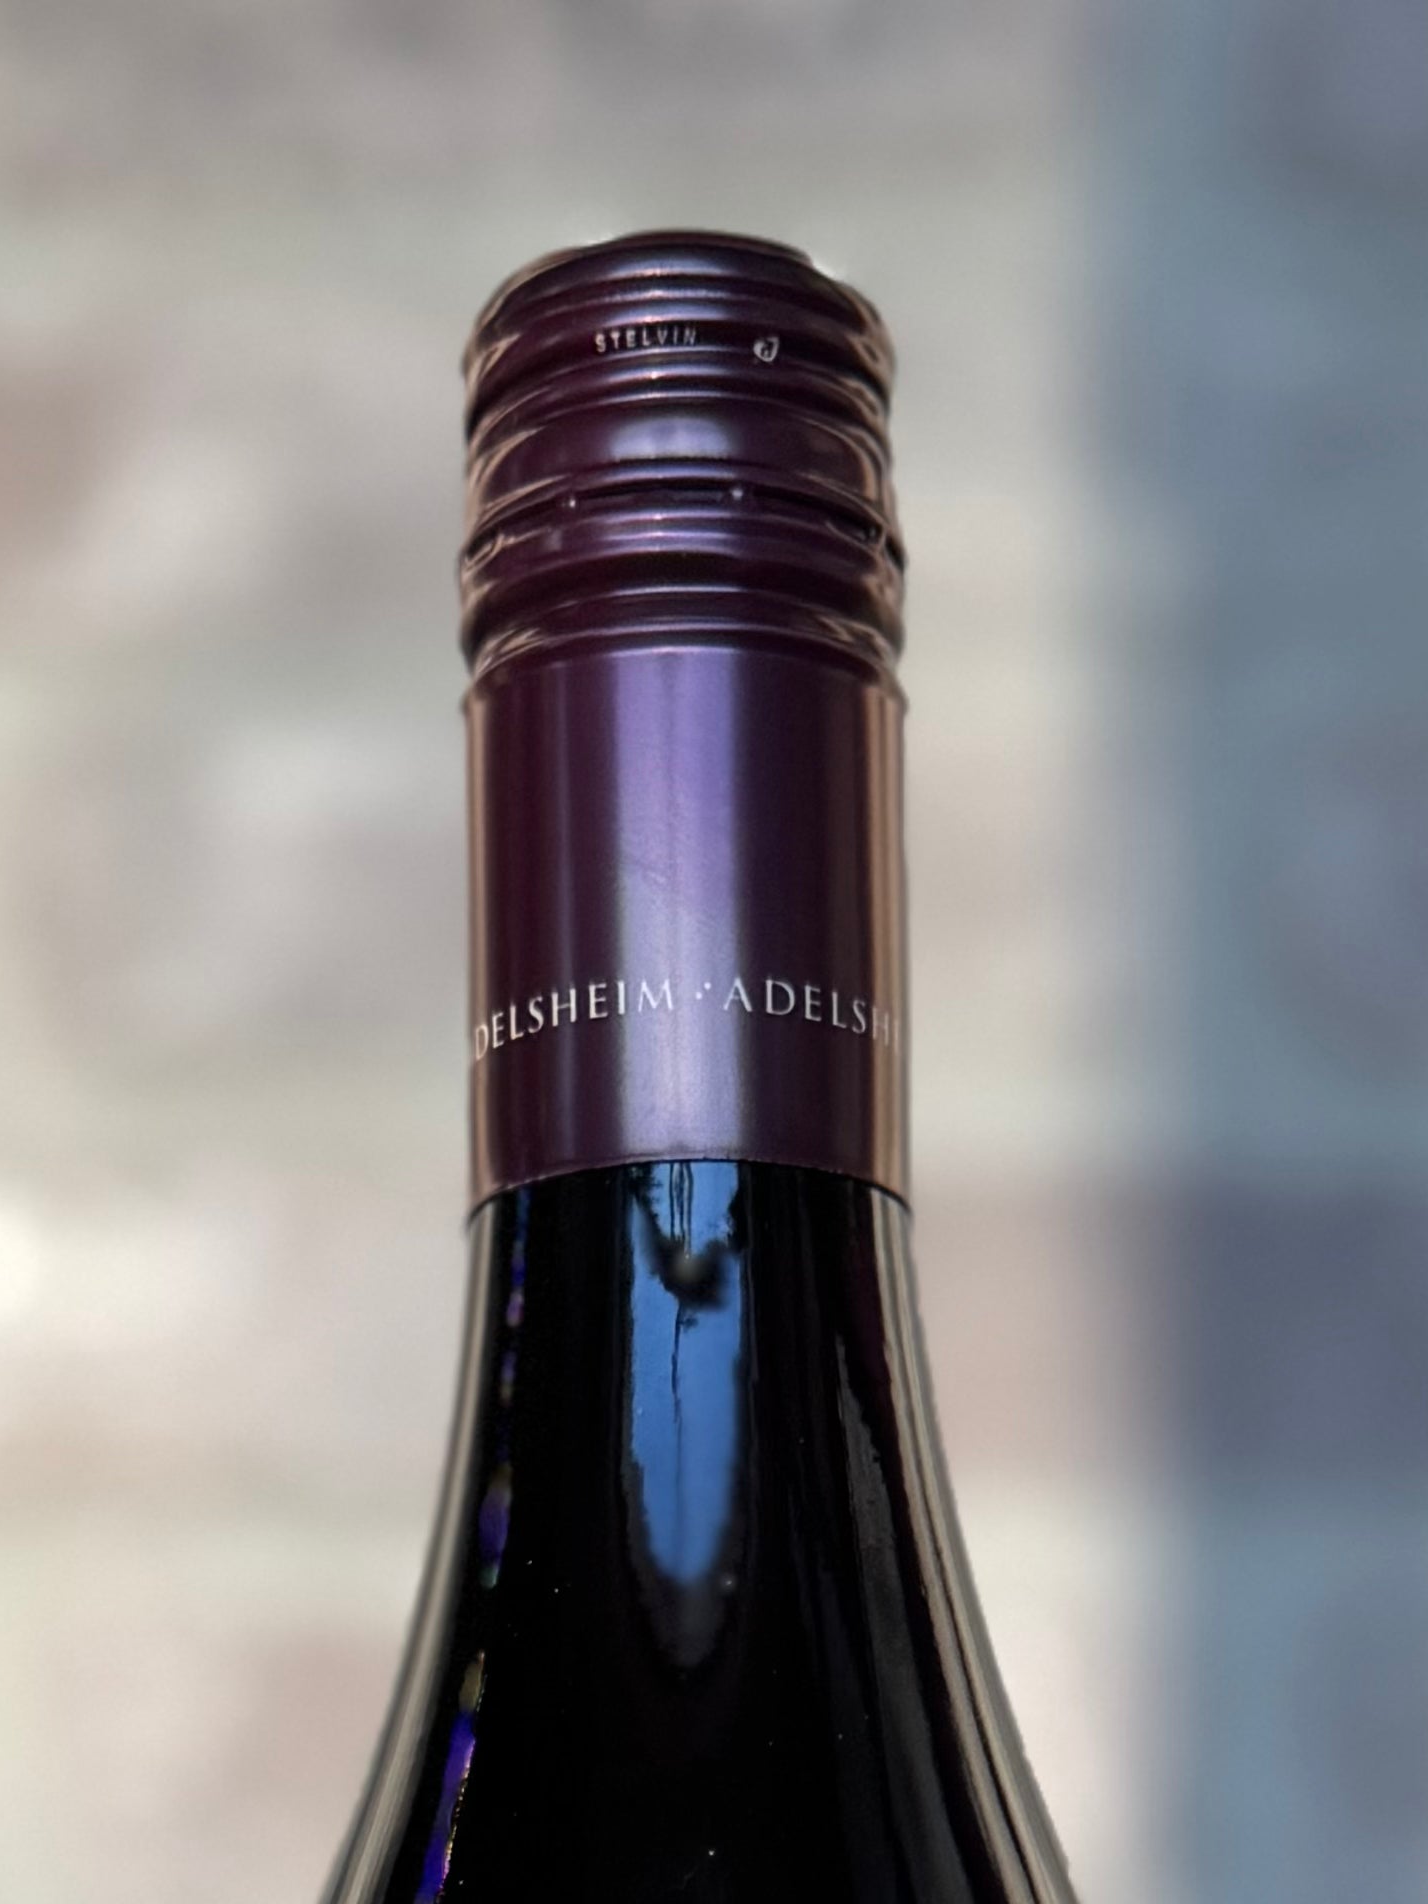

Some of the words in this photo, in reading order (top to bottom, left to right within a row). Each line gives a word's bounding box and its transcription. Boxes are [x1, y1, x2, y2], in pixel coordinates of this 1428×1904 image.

[595, 326, 697, 353] STELVIN
[474, 978, 673, 1061] DELSHEIM
[722, 977, 899, 1053] ADELSH
